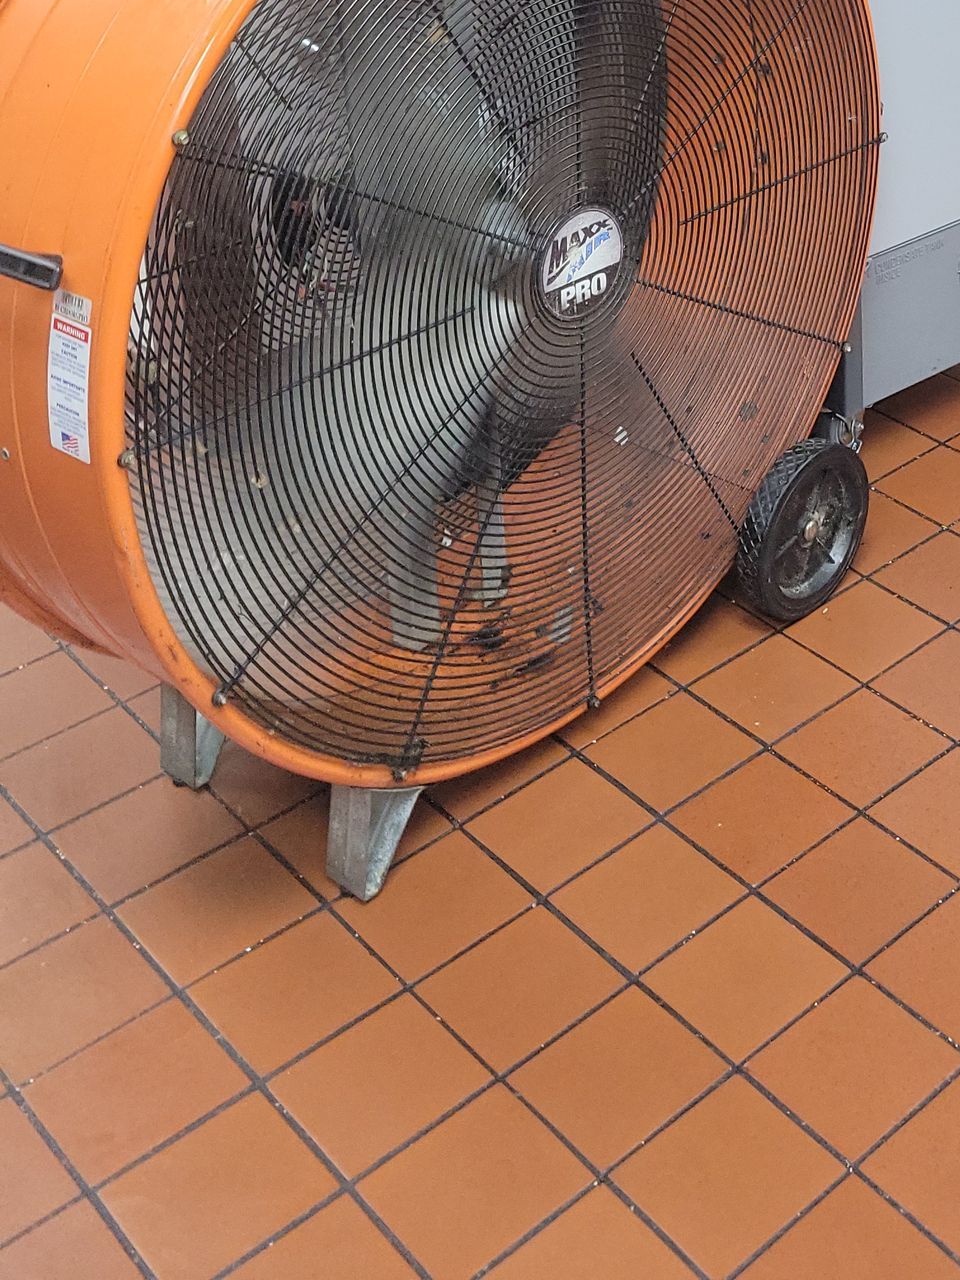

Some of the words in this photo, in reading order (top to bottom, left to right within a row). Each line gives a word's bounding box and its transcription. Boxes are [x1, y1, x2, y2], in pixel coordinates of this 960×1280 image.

[547, 218, 613, 276] MAXX
[560, 272, 607, 311] PRO
[57, 321, 86, 340] WARNING
